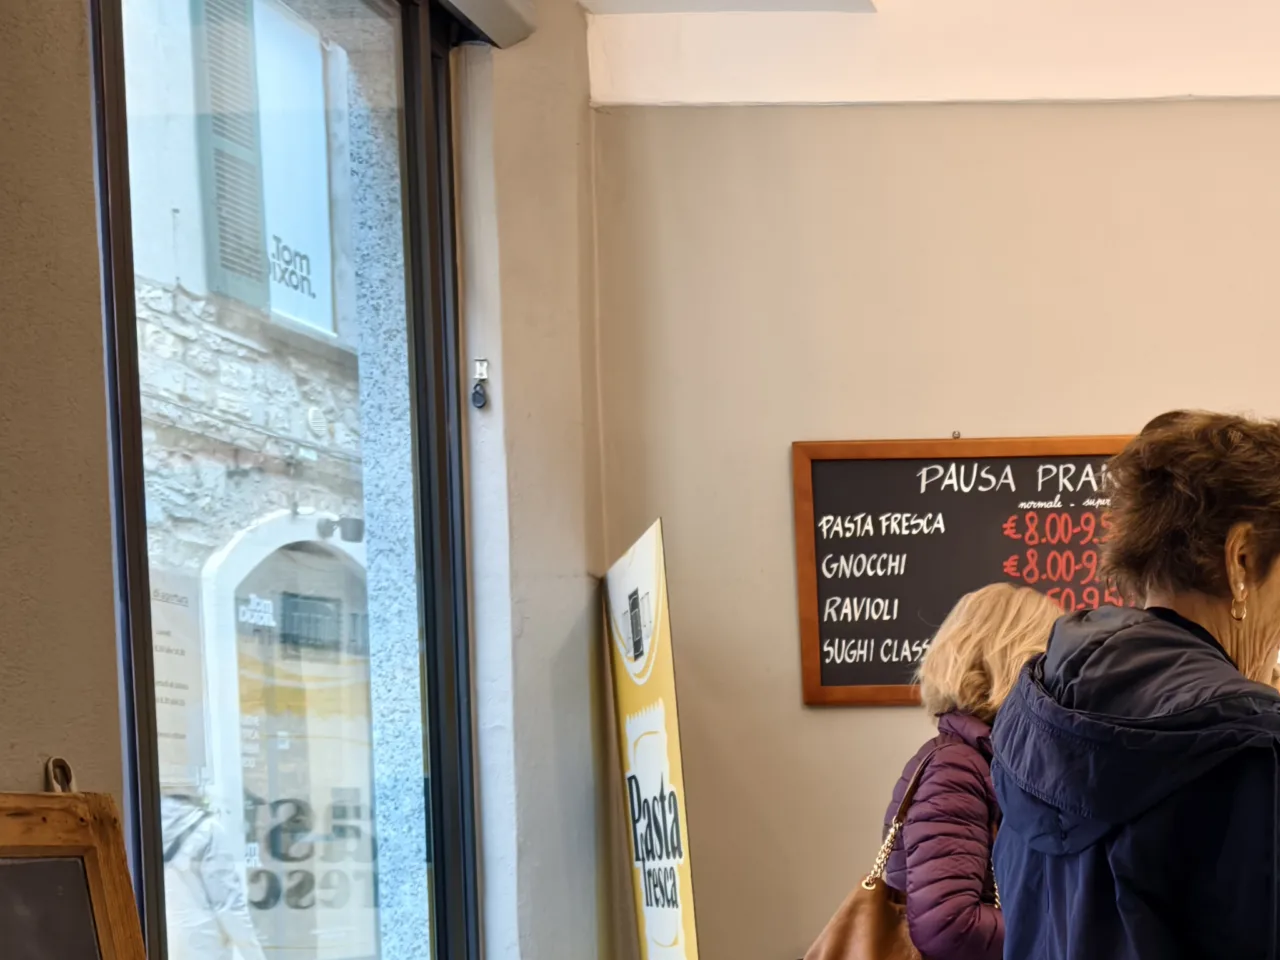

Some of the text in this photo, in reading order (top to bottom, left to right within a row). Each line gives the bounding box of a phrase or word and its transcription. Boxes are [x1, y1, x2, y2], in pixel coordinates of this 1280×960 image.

[273, 233, 311, 276] Tom
[269, 252, 316, 299] ixon.
[916, 462, 1016, 494] PAUSA
[1018, 494, 1062, 509] normale
[1082, 498, 1111, 509] super
[818, 512, 945, 539] PASTA FRESCA
[822, 553, 907, 578] GNOCCHI
[824, 596, 899, 622] RAVIOLI
[823, 638, 875, 664] SUGHI
[627, 772, 683, 861] Pasta
[640, 831, 679, 908] fresca
